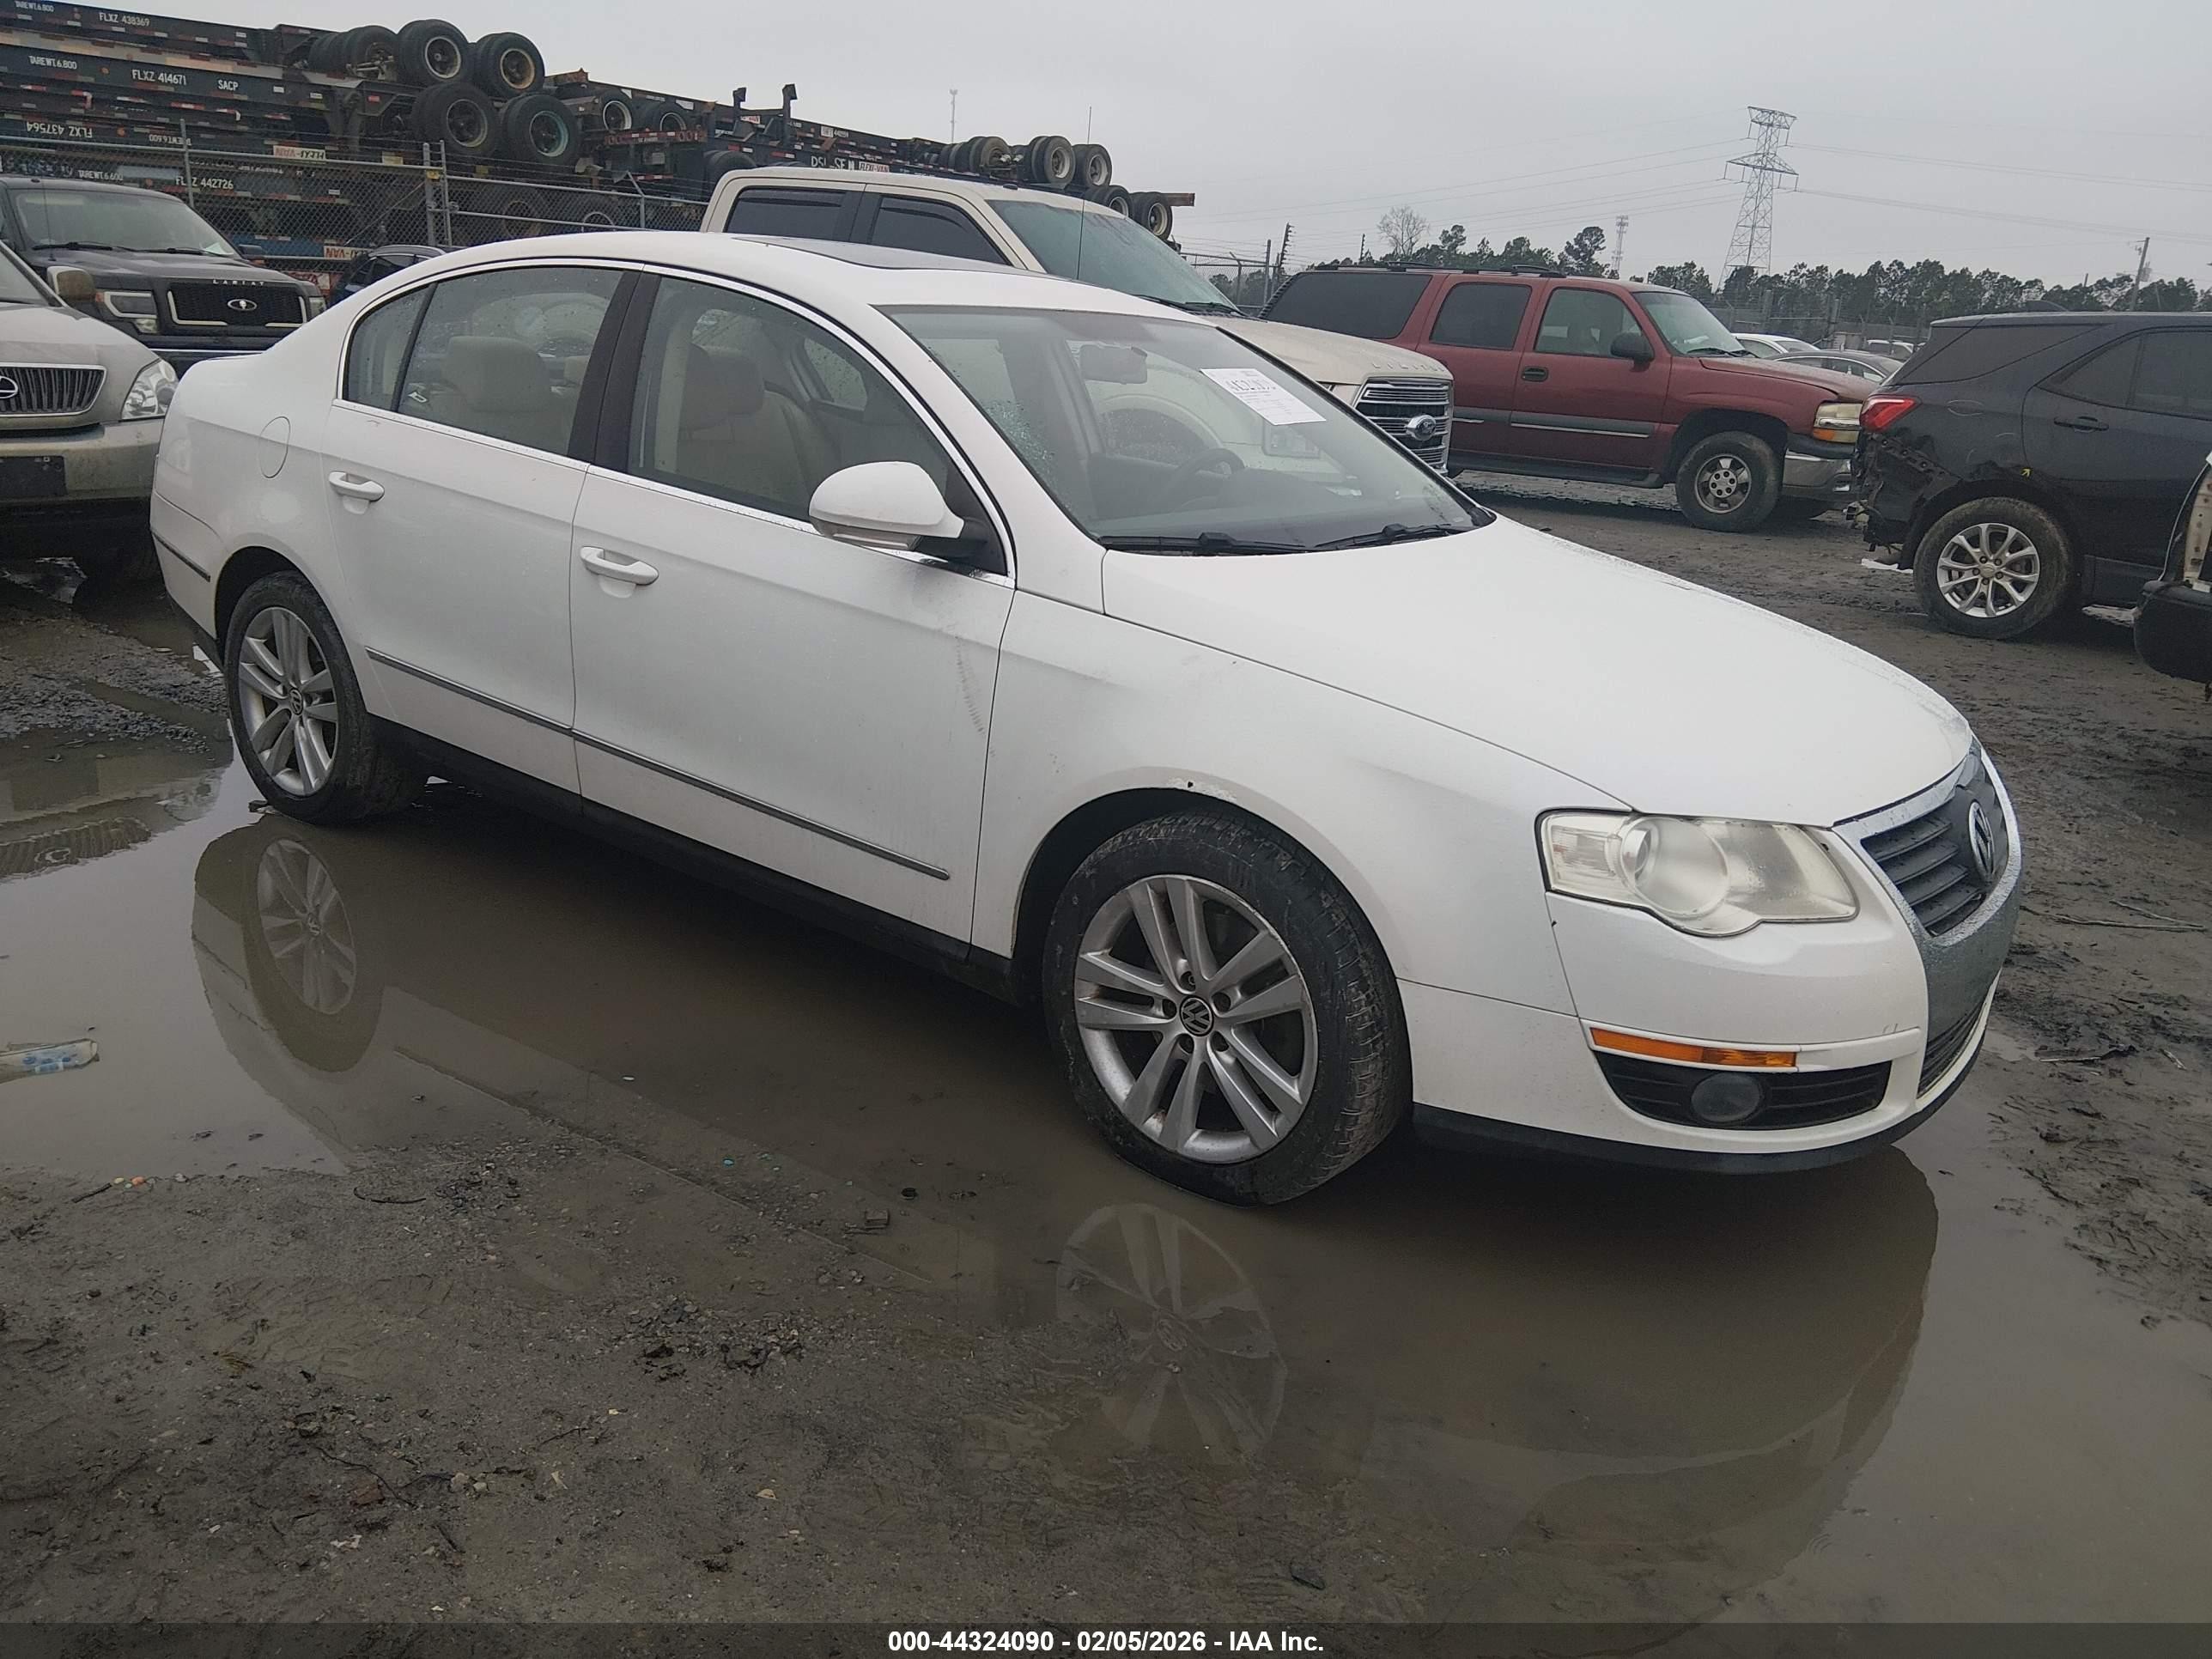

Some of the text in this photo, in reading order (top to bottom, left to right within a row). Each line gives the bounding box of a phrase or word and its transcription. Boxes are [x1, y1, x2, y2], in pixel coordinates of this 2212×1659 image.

[99, 12, 118, 22] FLXZ
[131, 70, 186, 85] FLXZ 414671
[218, 80, 239, 91] SACP
[68, 126, 93, 138] FLXZ
[200, 178, 234, 190] 442726
